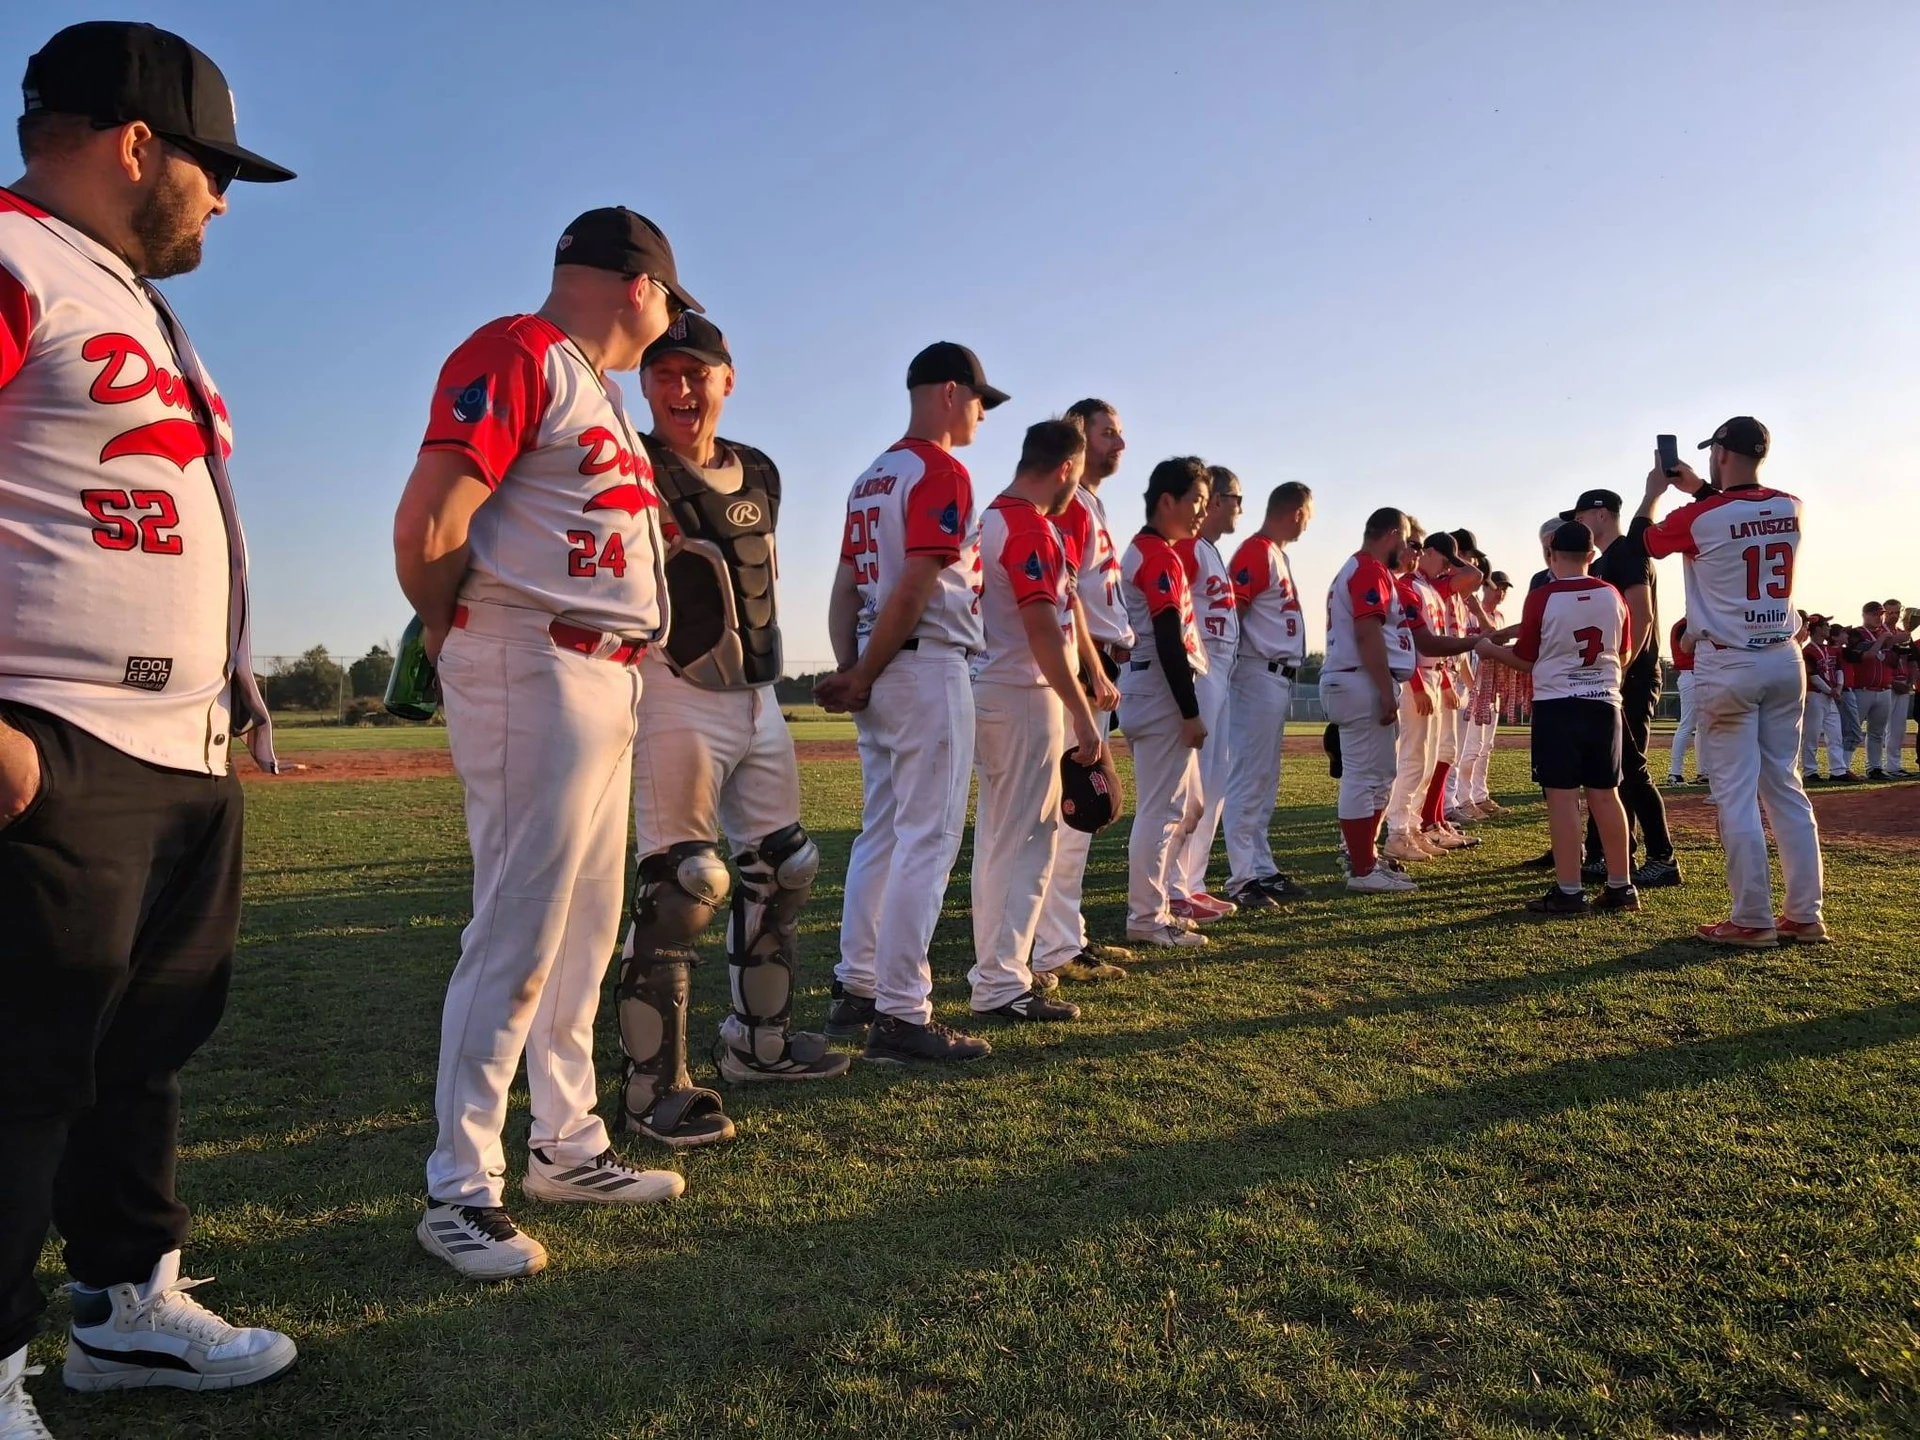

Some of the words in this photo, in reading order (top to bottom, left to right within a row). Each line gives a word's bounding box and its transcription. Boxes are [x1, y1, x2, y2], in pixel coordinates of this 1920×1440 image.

[80, 489, 183, 556] 52
[567, 530, 626, 578] 24
[1742, 542, 1793, 600] 13
[1744, 609, 1788, 622] Unilin
[1204, 617, 1226, 636] 57
[1286, 618, 1297, 637] 9
[1573, 626, 1604, 667] 7
[130, 660, 170, 671] COOL
[127, 671, 168, 682] GEAR
